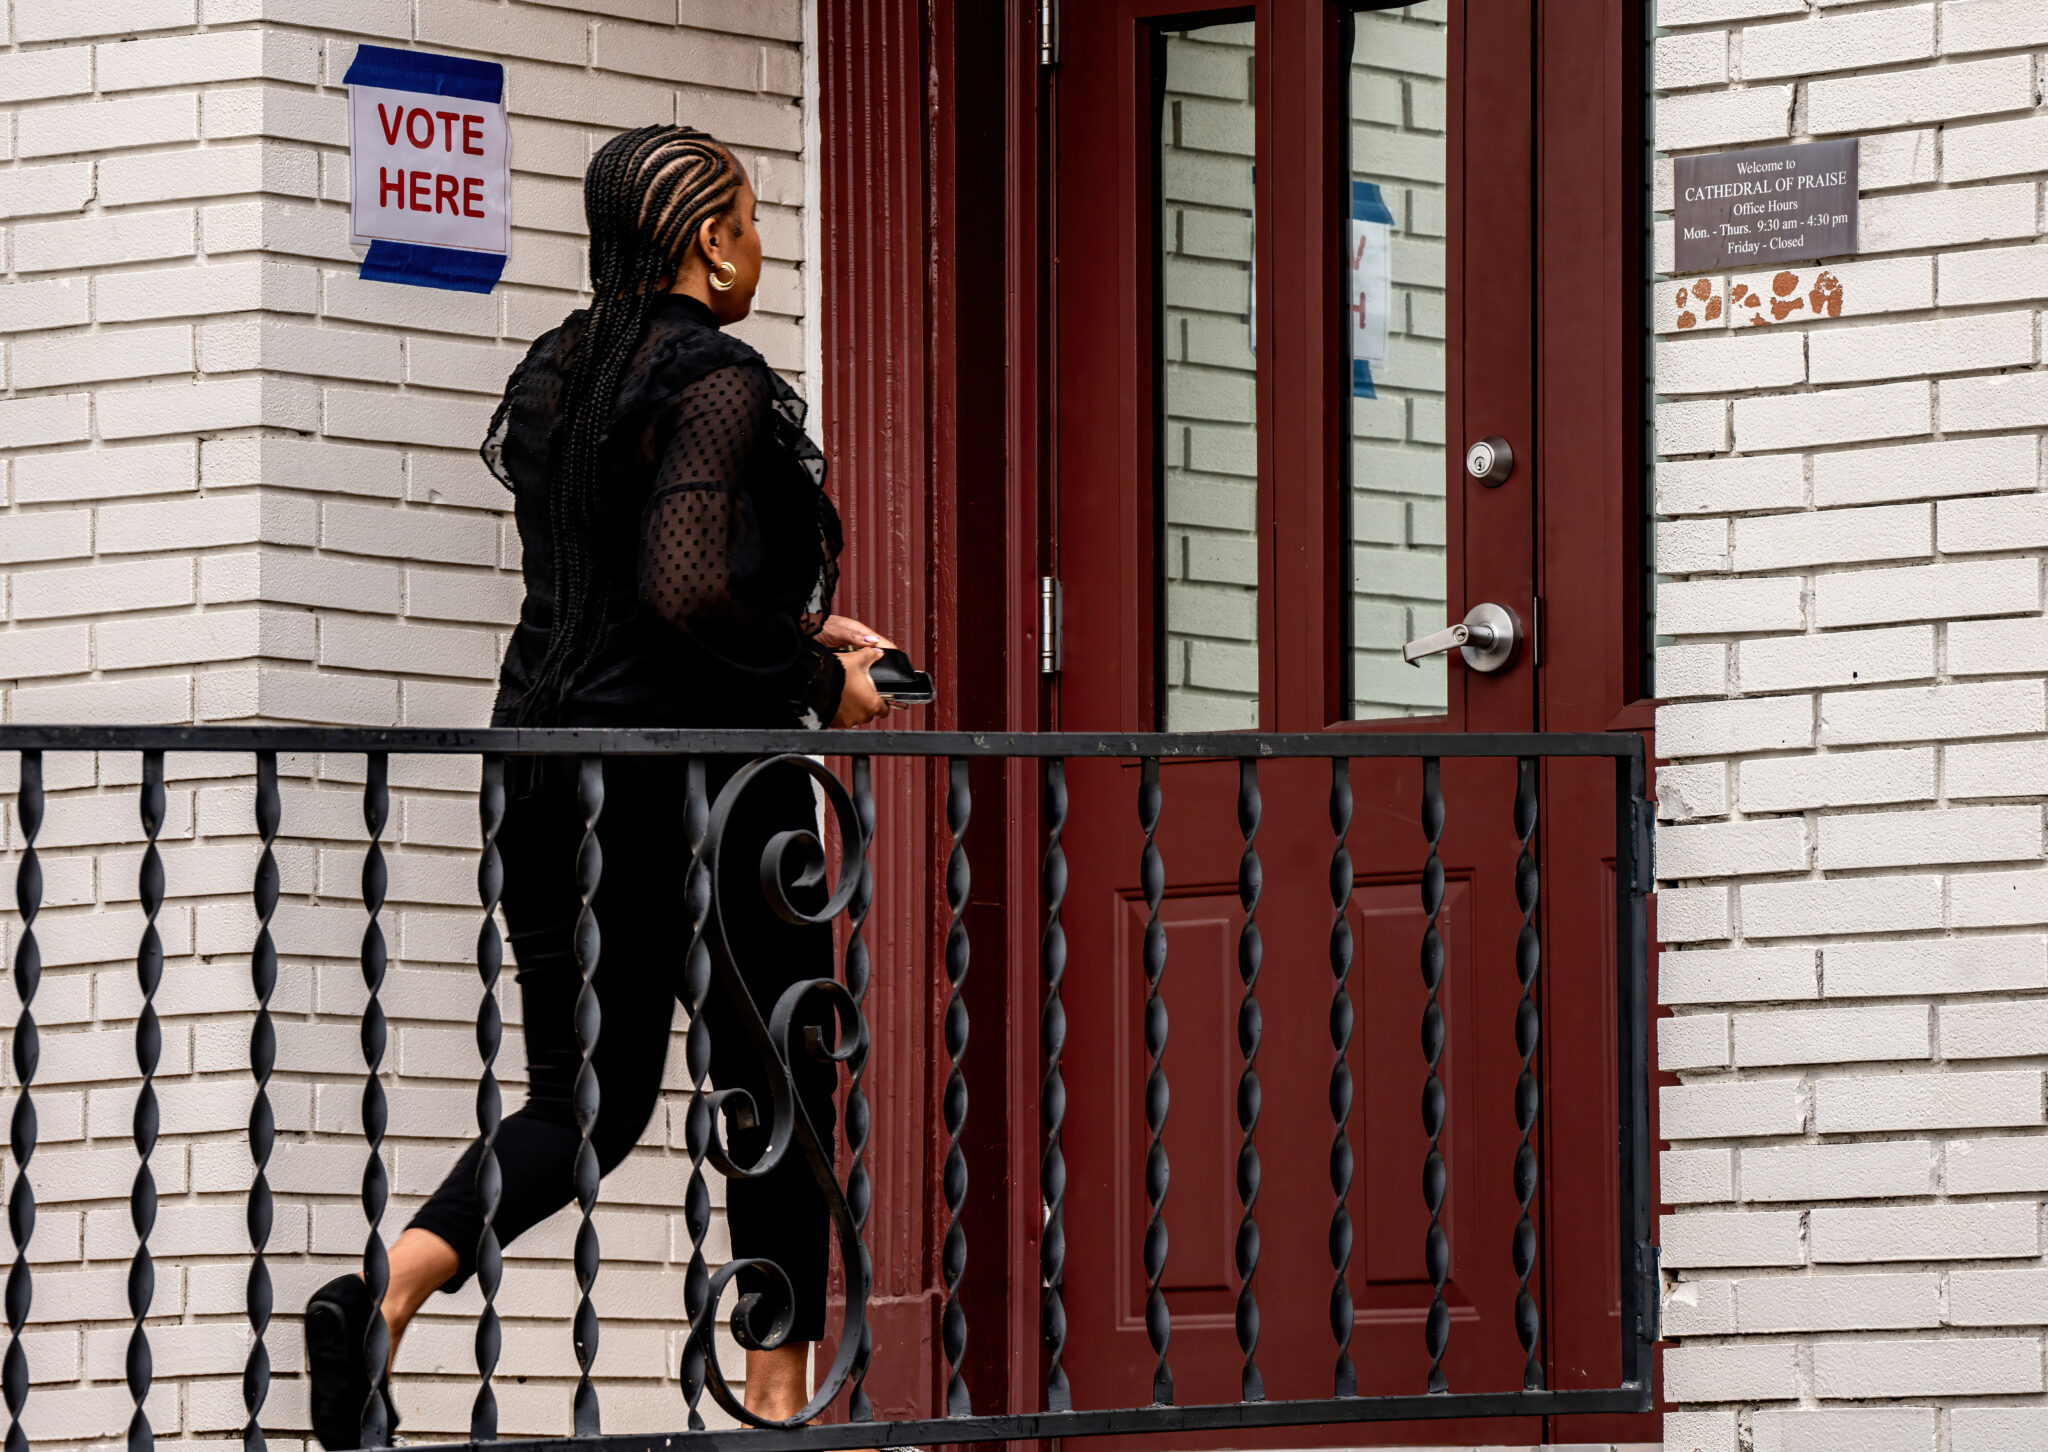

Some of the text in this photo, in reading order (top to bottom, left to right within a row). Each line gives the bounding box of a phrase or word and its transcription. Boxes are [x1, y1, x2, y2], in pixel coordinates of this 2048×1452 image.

[377, 103, 485, 156] VOTE
[1737, 159, 1796, 175] Welcome to
[379, 166, 486, 219] HERE
[1685, 171, 1847, 201] CATHEDRAL OF PRAISE
[1733, 200, 1798, 216] Office Hours
[1683, 228, 1710, 240] Mon.
[1719, 223, 1751, 236] Thurs.
[1757, 219, 1780, 232] 9:30
[1782, 220, 1798, 229] am
[1807, 213, 1830, 227] 4:30
[1832, 213, 1848, 228] pm
[1727, 241, 1760, 254] Friday
[1769, 235, 1804, 250] Closed
